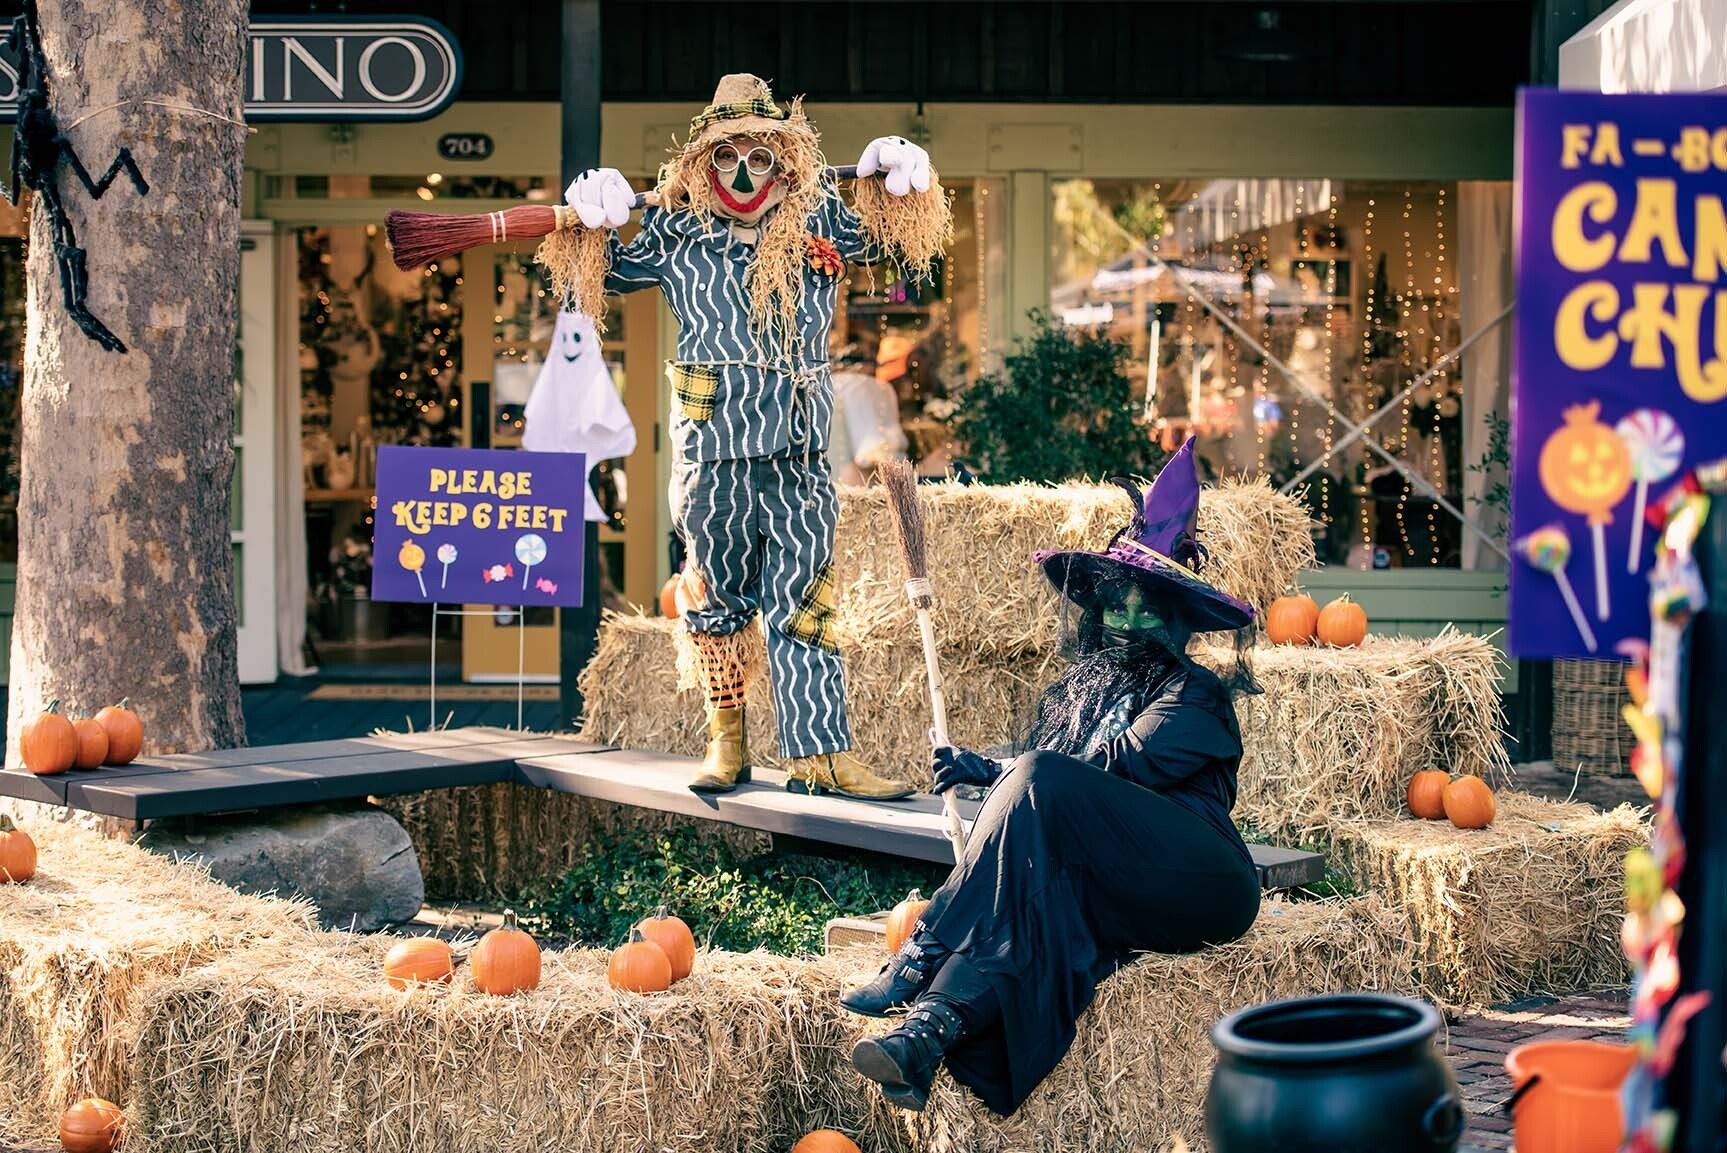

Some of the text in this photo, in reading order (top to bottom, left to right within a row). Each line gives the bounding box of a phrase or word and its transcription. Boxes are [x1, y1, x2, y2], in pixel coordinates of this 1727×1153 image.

[444, 138, 487, 154] 704
[429, 468, 532, 500] PLEASE
[391, 500, 568, 534] KEEP 6 FEET
